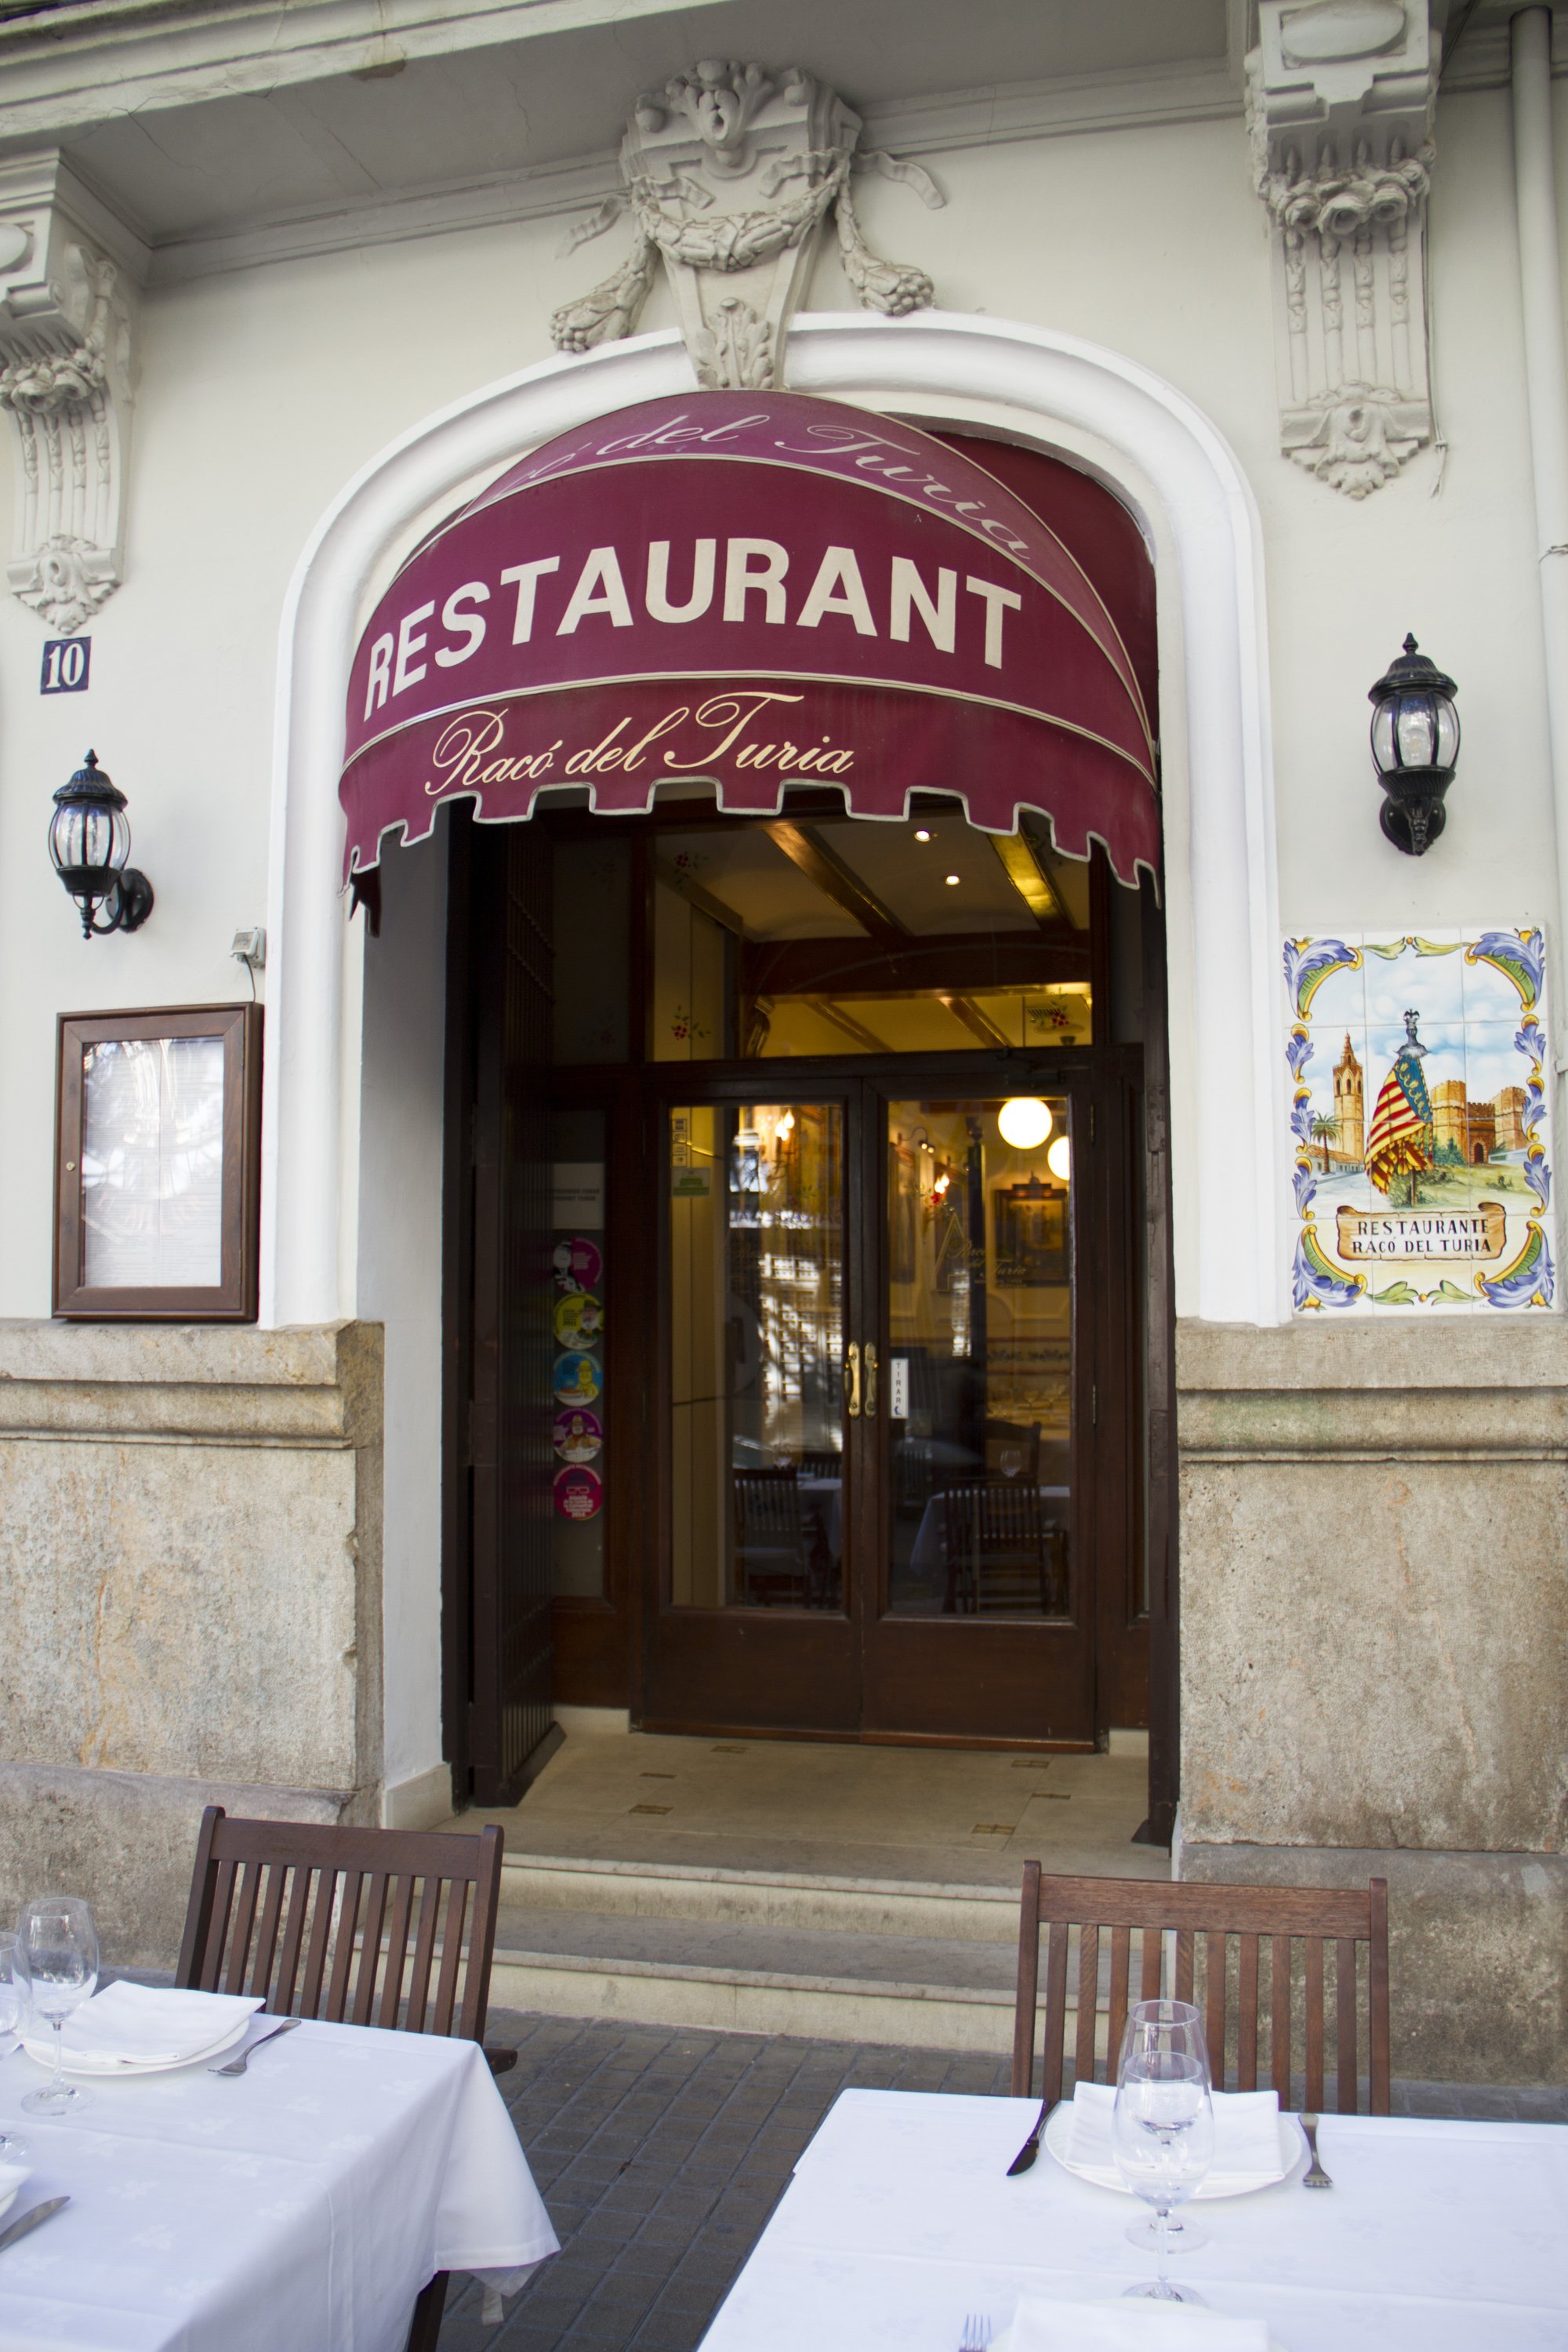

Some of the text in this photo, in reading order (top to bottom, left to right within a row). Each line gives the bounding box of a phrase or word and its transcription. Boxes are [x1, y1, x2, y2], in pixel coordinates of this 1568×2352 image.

[595, 415, 770, 456] del
[774, 424, 1031, 560] Turia
[45, 642, 85, 688] 10
[363, 537, 1022, 721] RESTAURANT
[424, 691, 855, 795] Racó del Turia
[1352, 1236, 1492, 1254] RACÓ DEL TURIA
[1357, 1218, 1490, 1236] RESTAURANTE
